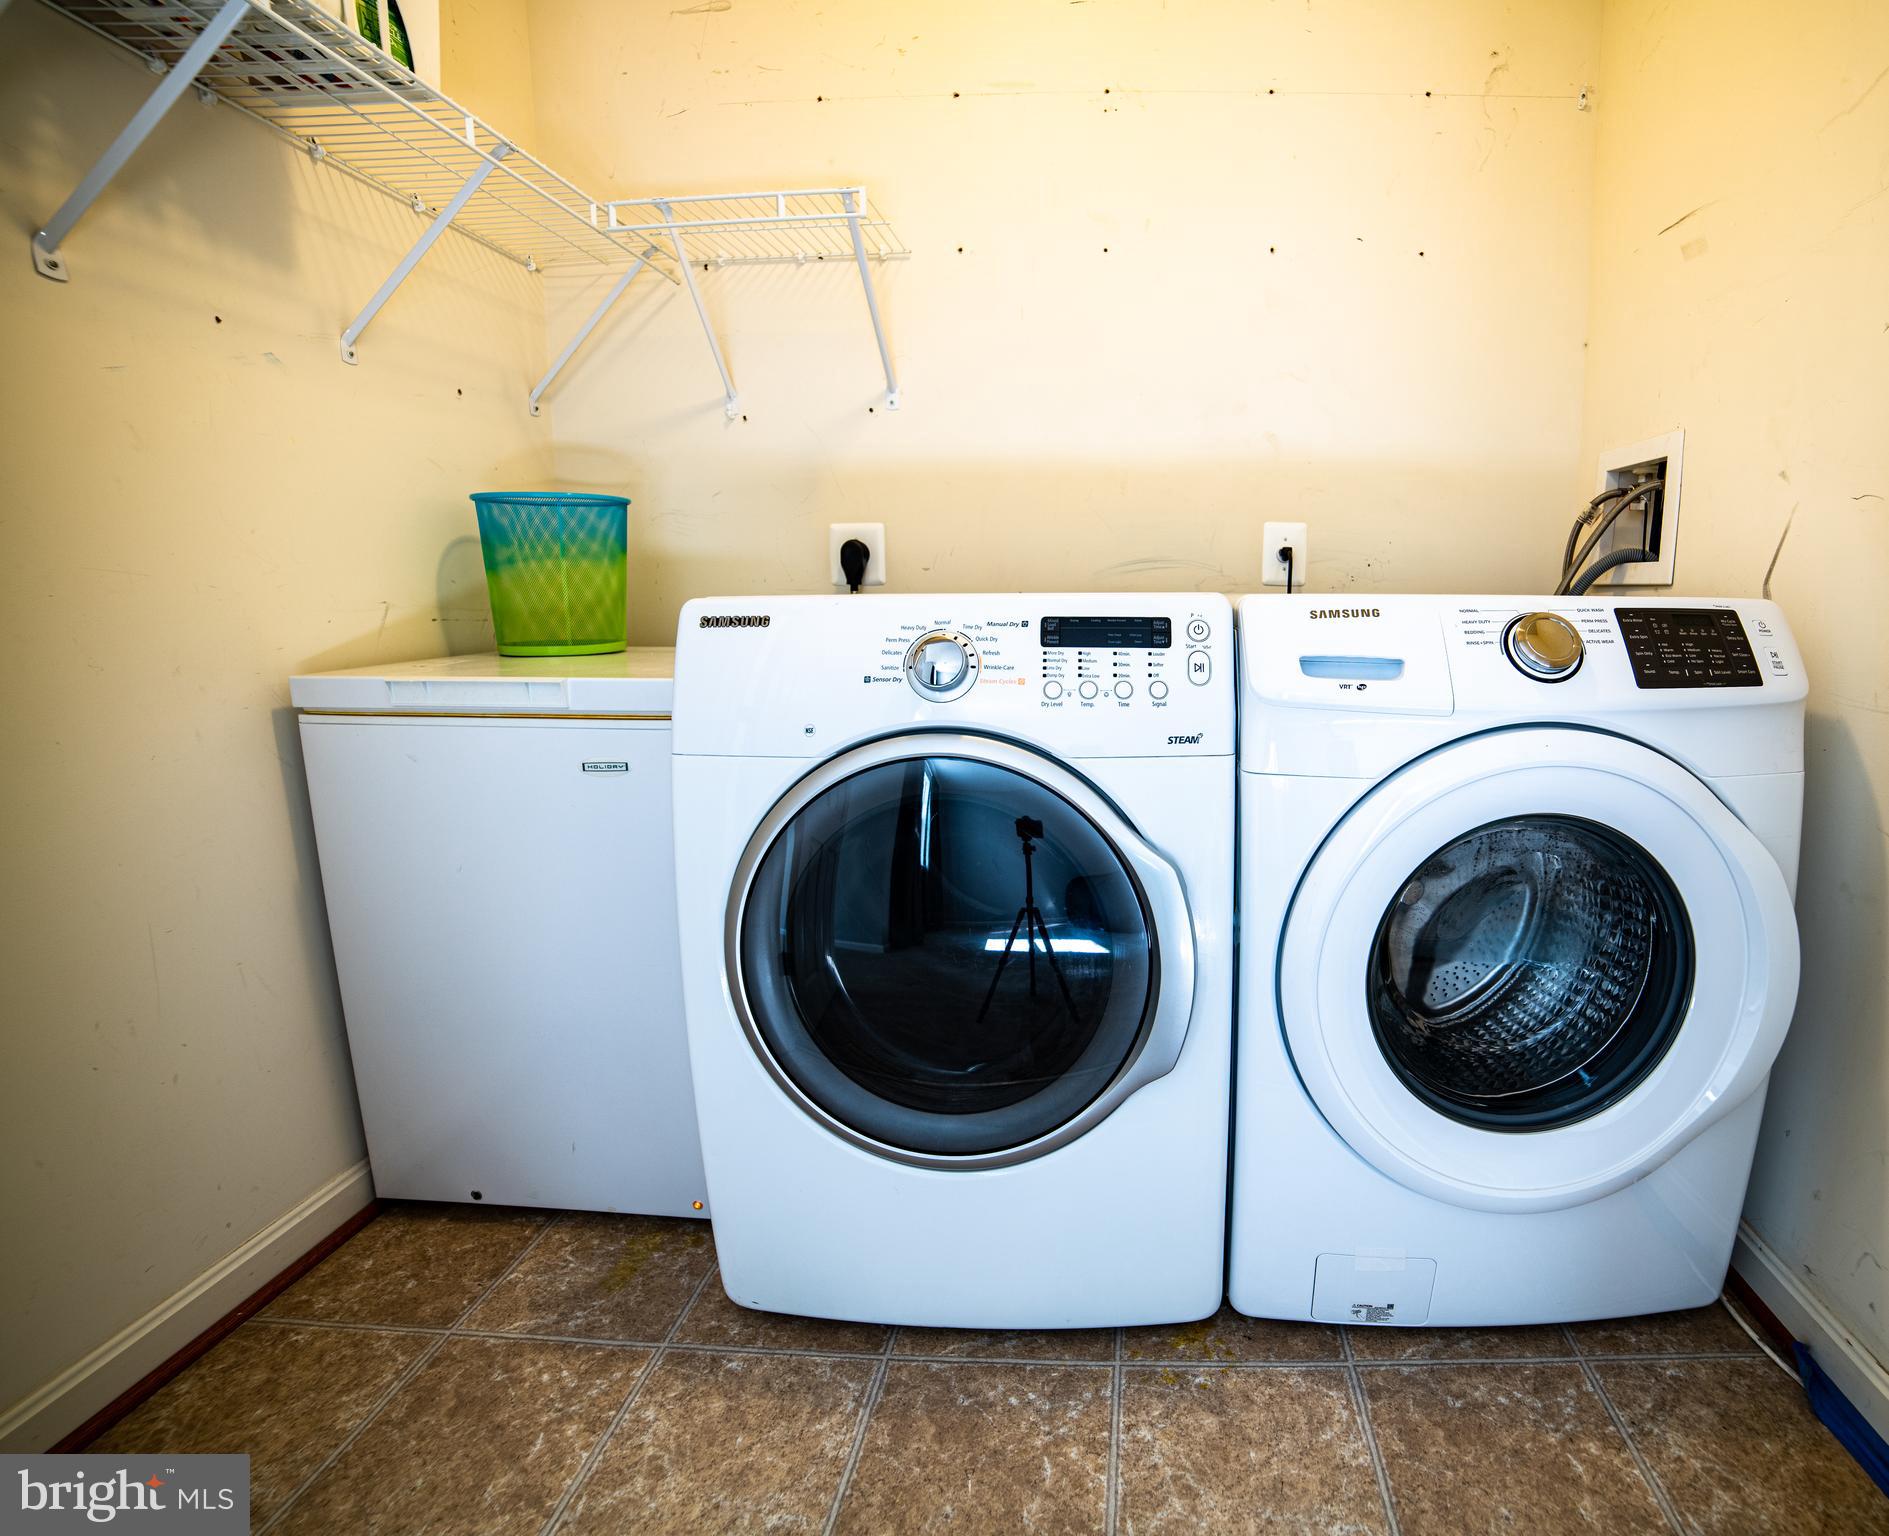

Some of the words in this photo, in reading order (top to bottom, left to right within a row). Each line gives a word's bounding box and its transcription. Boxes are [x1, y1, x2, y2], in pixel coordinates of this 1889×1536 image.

[1310, 608, 1380, 619] SAMSUNG
[700, 616, 770, 628] SAMSUNG
[1168, 736, 1200, 744] STEAM
